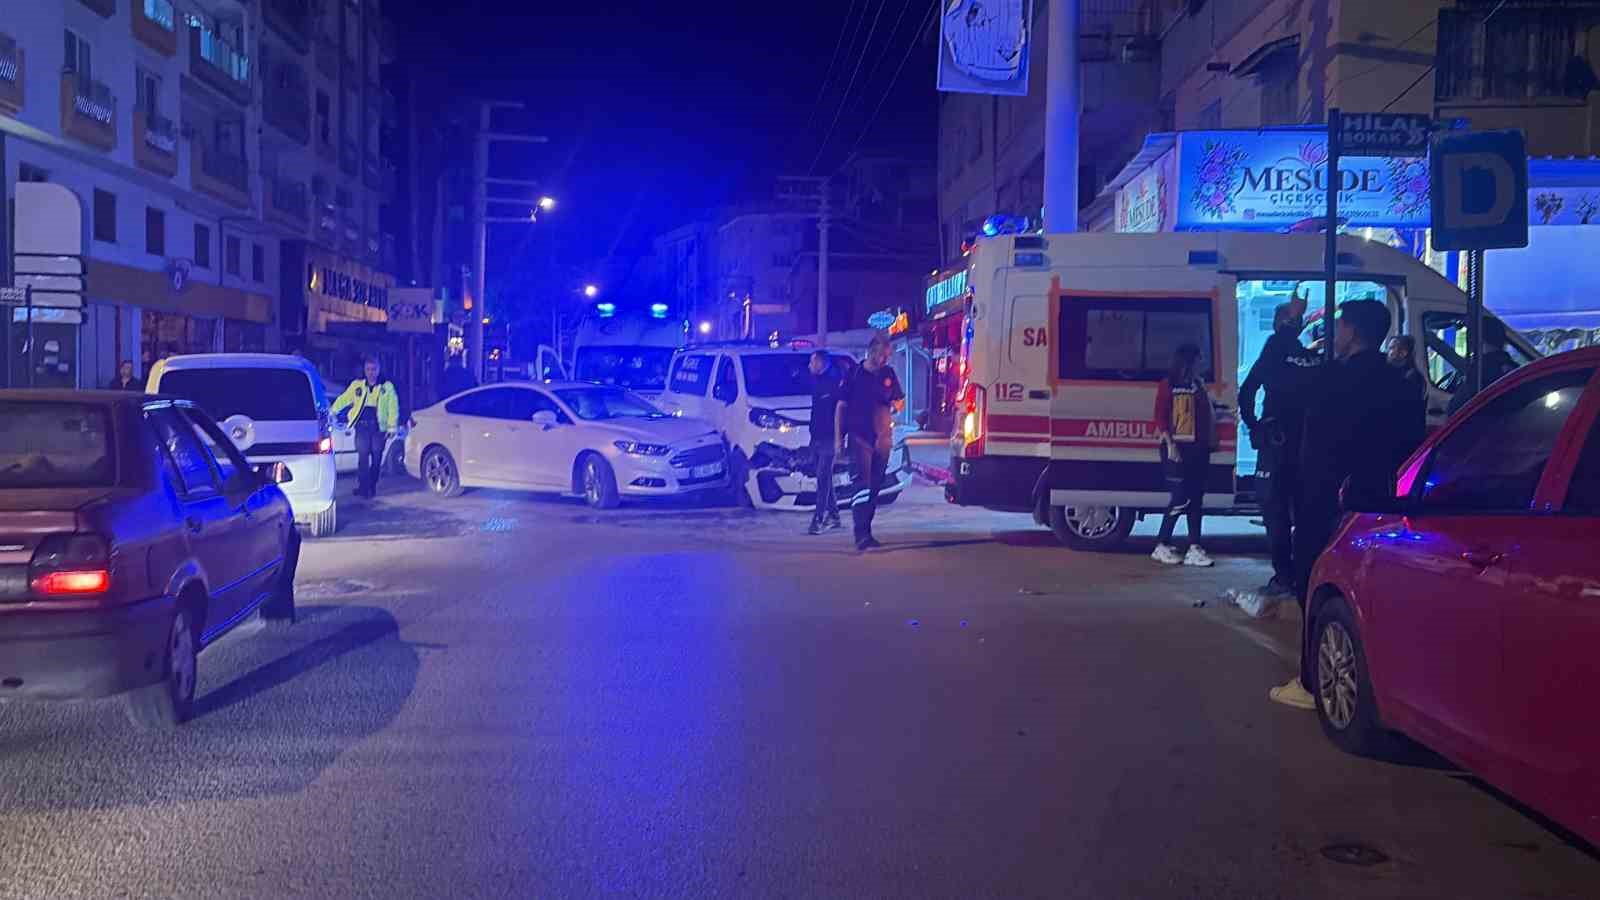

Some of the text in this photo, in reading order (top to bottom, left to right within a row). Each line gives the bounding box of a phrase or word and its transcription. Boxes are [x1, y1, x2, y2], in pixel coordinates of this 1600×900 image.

[1233, 167, 1385, 198] MESUDE
[1443, 153, 1516, 229] D
[995, 383, 1024, 401] 112
